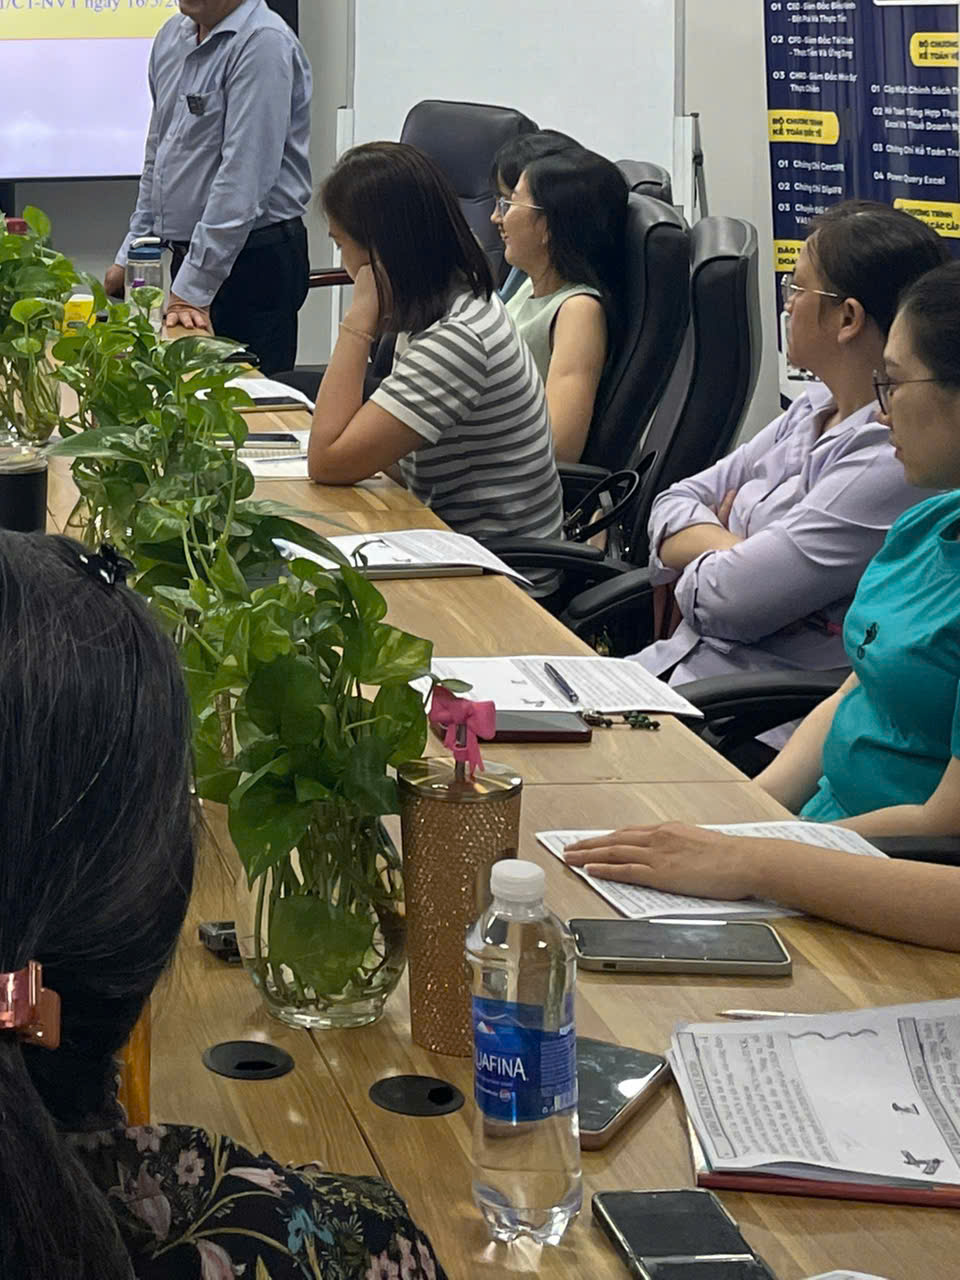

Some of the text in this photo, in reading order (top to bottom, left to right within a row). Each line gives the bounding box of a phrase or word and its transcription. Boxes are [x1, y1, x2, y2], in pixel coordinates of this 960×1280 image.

[771, 3, 781, 11] 01
[771, 36, 783, 44] 02
[773, 72, 785, 80] 03
[778, 160, 788, 168] 01
[778, 182, 790, 190] 02
[778, 203, 790, 211] 03
